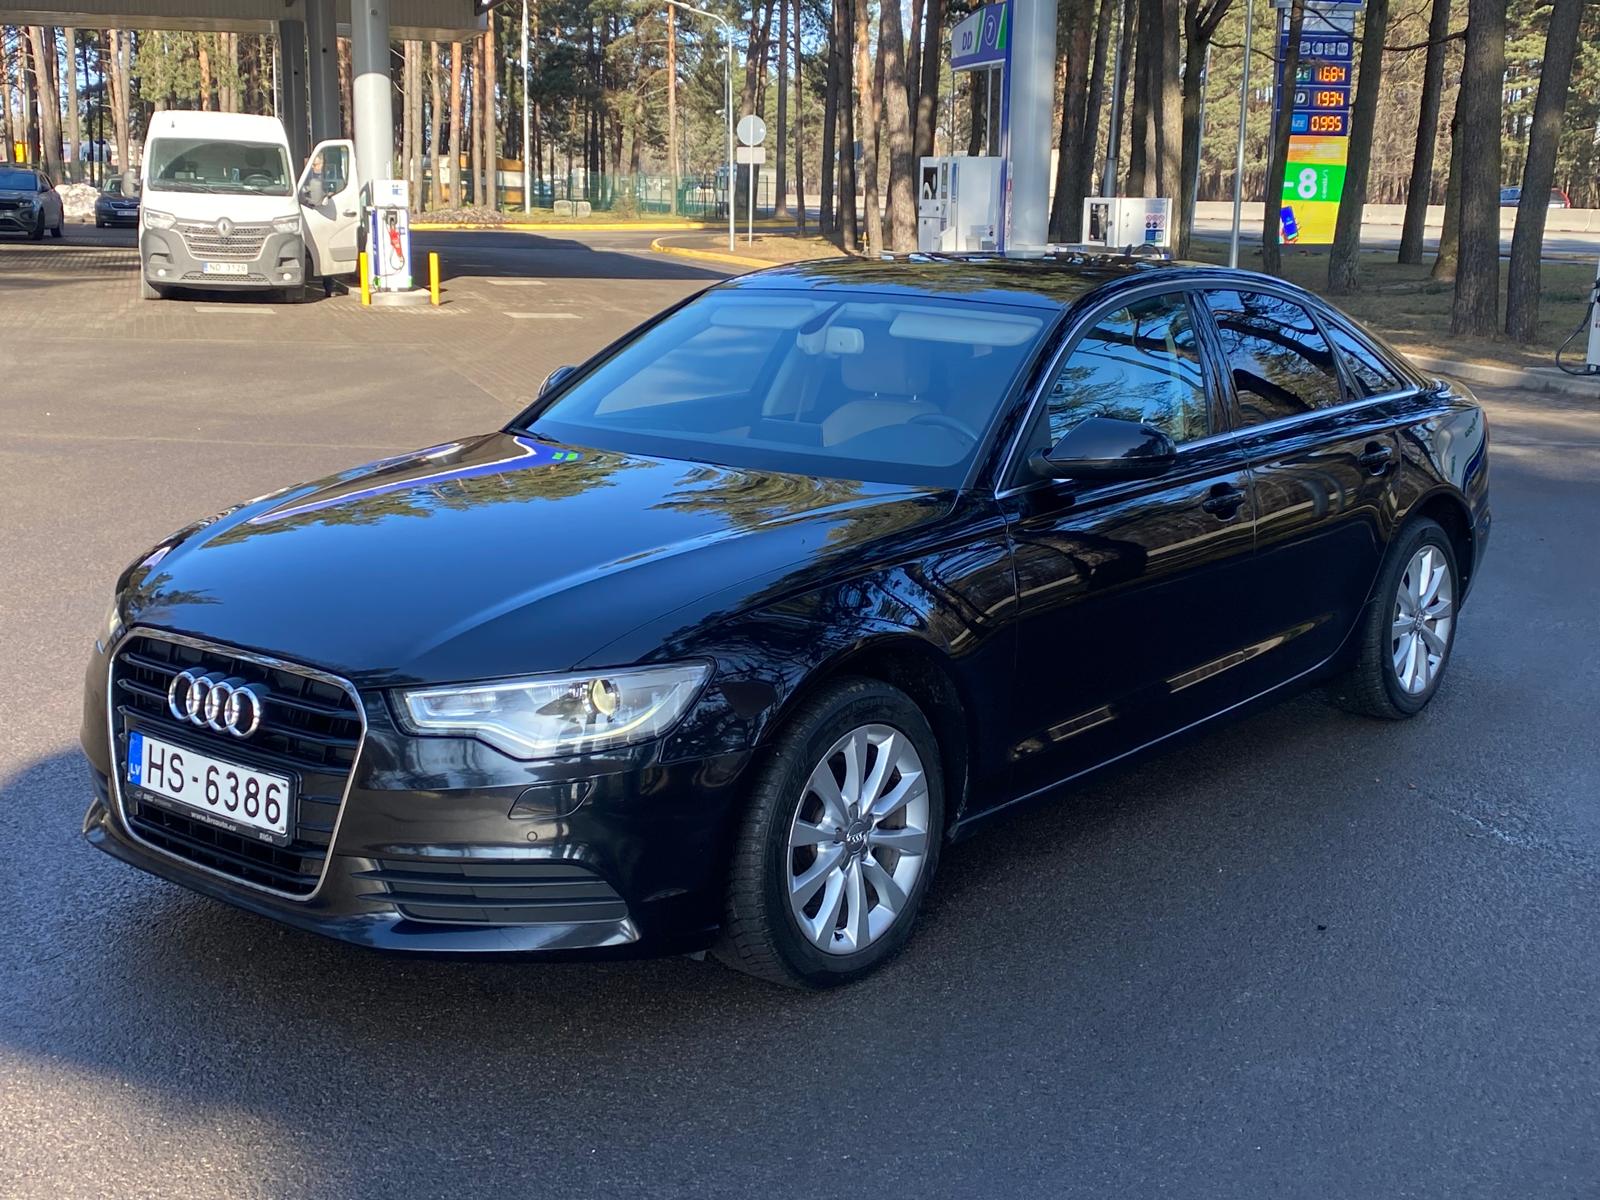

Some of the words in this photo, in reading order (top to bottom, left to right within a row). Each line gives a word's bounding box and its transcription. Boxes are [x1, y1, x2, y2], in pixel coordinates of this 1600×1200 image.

[962, 30, 973, 50] DD
[988, 21, 994, 40] 7
[130, 762, 142, 776] LV
[147, 743, 282, 825] HS-6386
